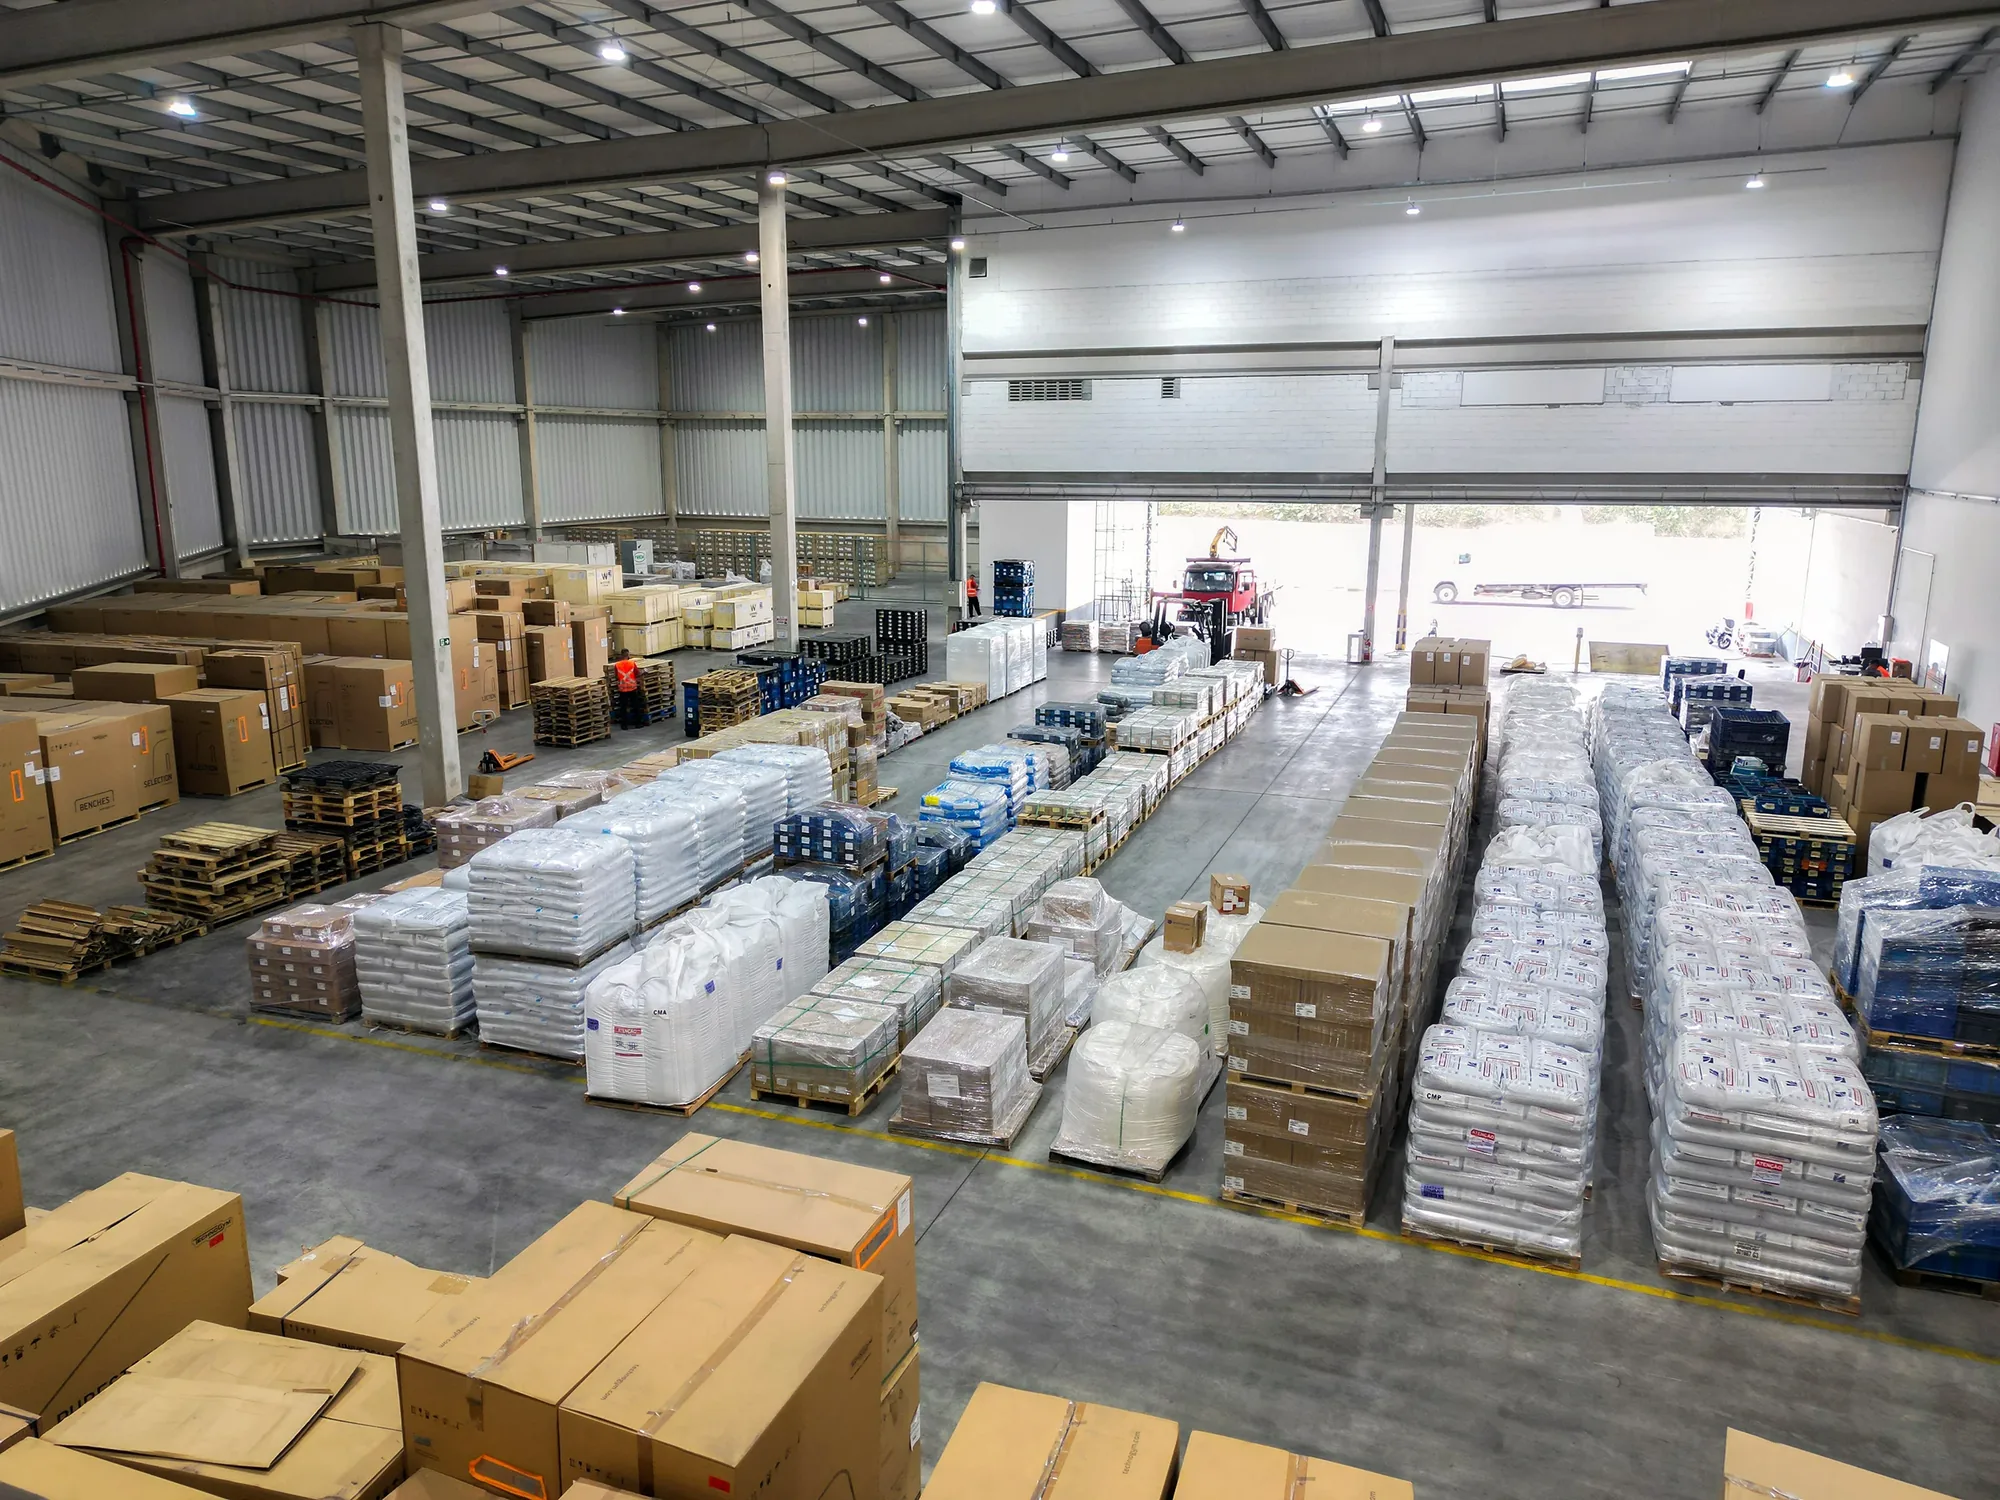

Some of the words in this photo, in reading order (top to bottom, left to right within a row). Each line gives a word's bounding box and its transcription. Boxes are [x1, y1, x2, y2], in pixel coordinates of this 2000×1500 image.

[144, 773, 173, 788] SELECTION
[79, 796, 110, 812] BENCHES
[1426, 1092, 1441, 1101] CMP
[600, 1363, 640, 1401] technogym.com
[1122, 1431, 1141, 1475] technogym.com
